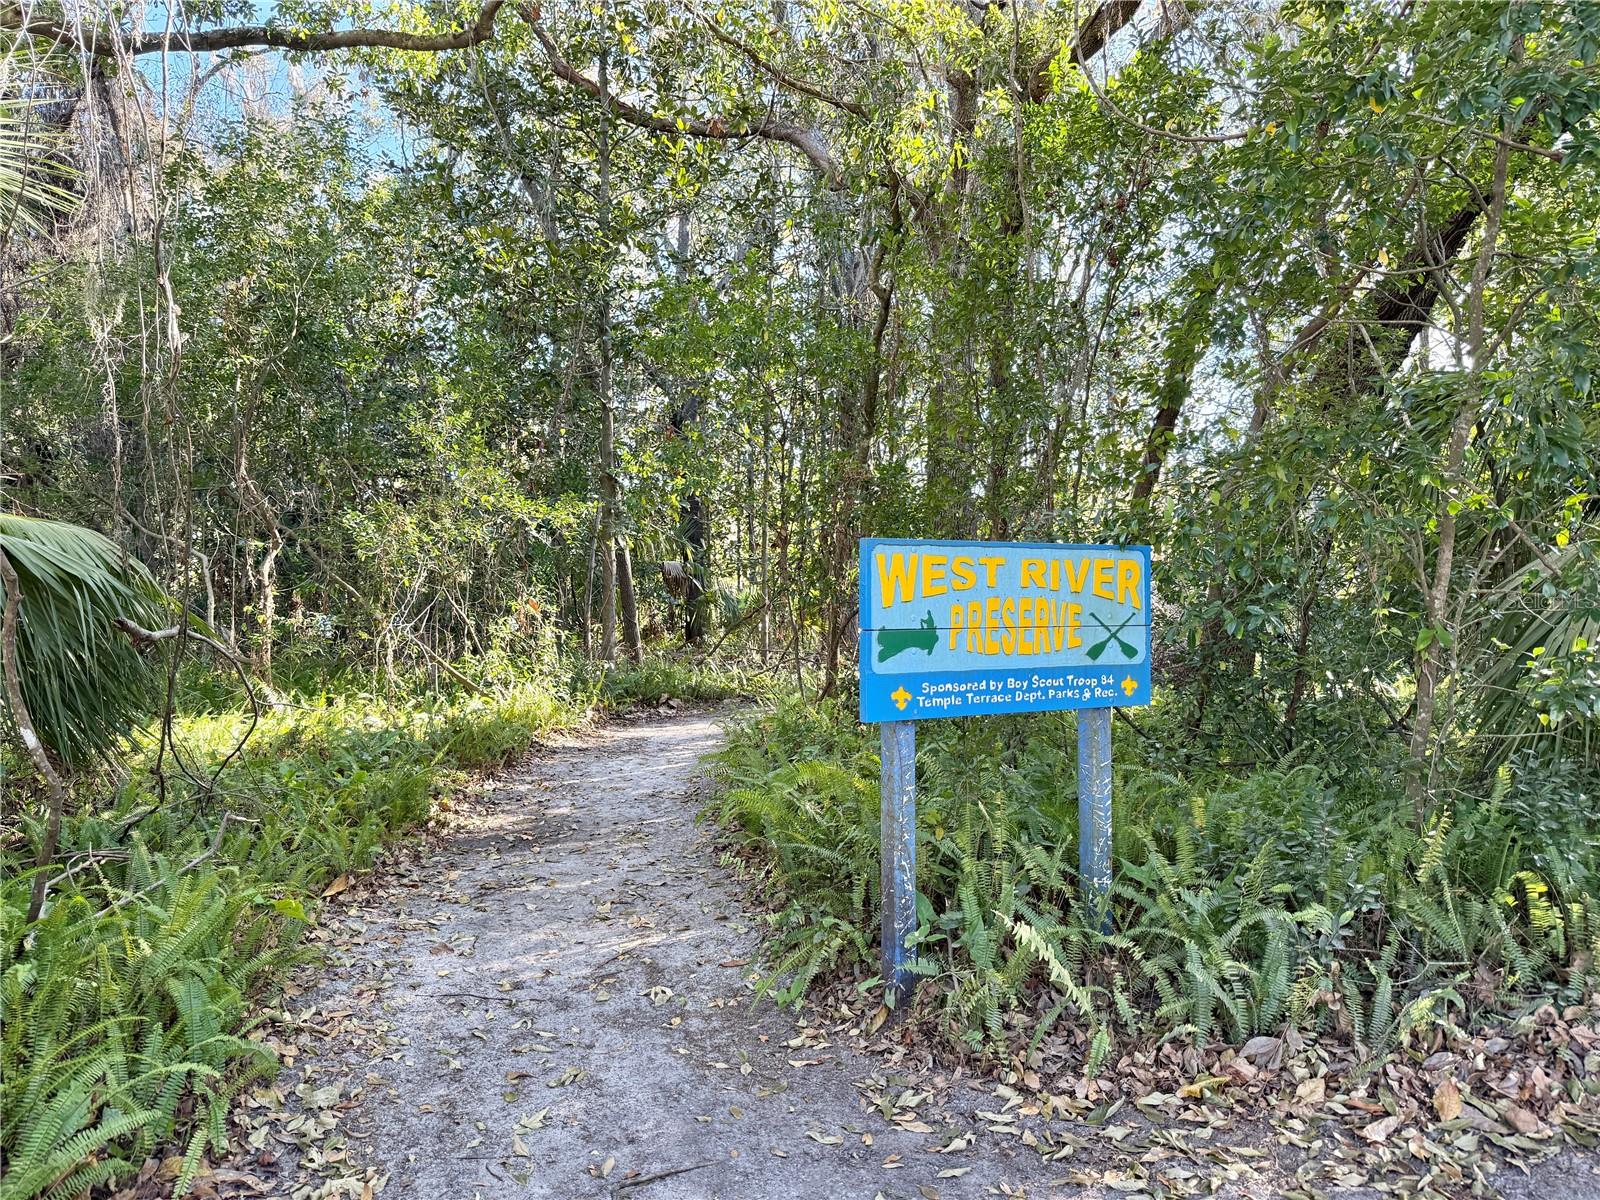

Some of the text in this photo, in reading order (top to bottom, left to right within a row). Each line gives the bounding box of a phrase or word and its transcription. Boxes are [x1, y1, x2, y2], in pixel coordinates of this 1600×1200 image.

[876, 553, 1141, 609] WEST RIVER
[949, 597, 1082, 655] PRESERVE
[916, 686, 1119, 710] Temple Terrace Dept. Parks & Rec.
[921, 674, 1115, 695] Sponsored by Boy Scout Troop 84
